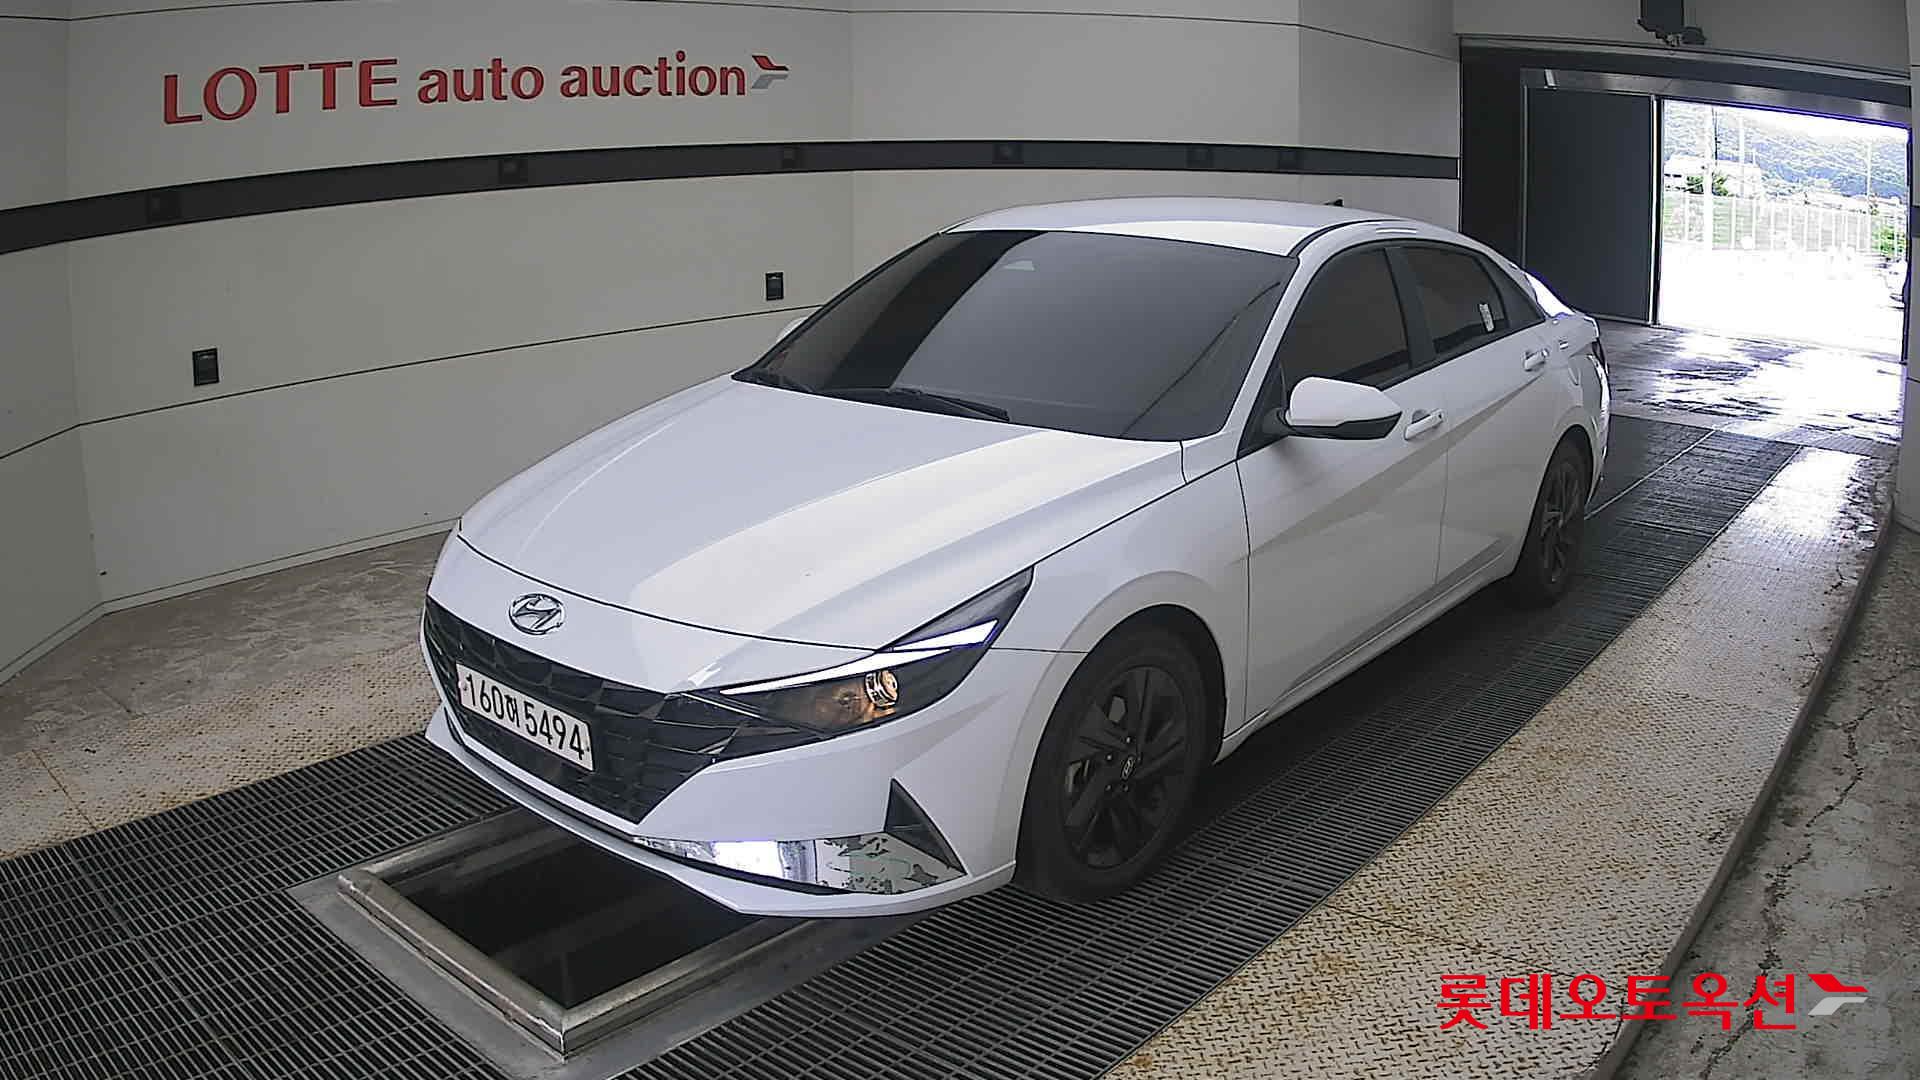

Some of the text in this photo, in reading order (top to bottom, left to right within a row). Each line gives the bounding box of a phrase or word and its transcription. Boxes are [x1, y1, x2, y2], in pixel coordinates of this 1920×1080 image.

[163, 50, 746, 125] LOTTE auto auction
